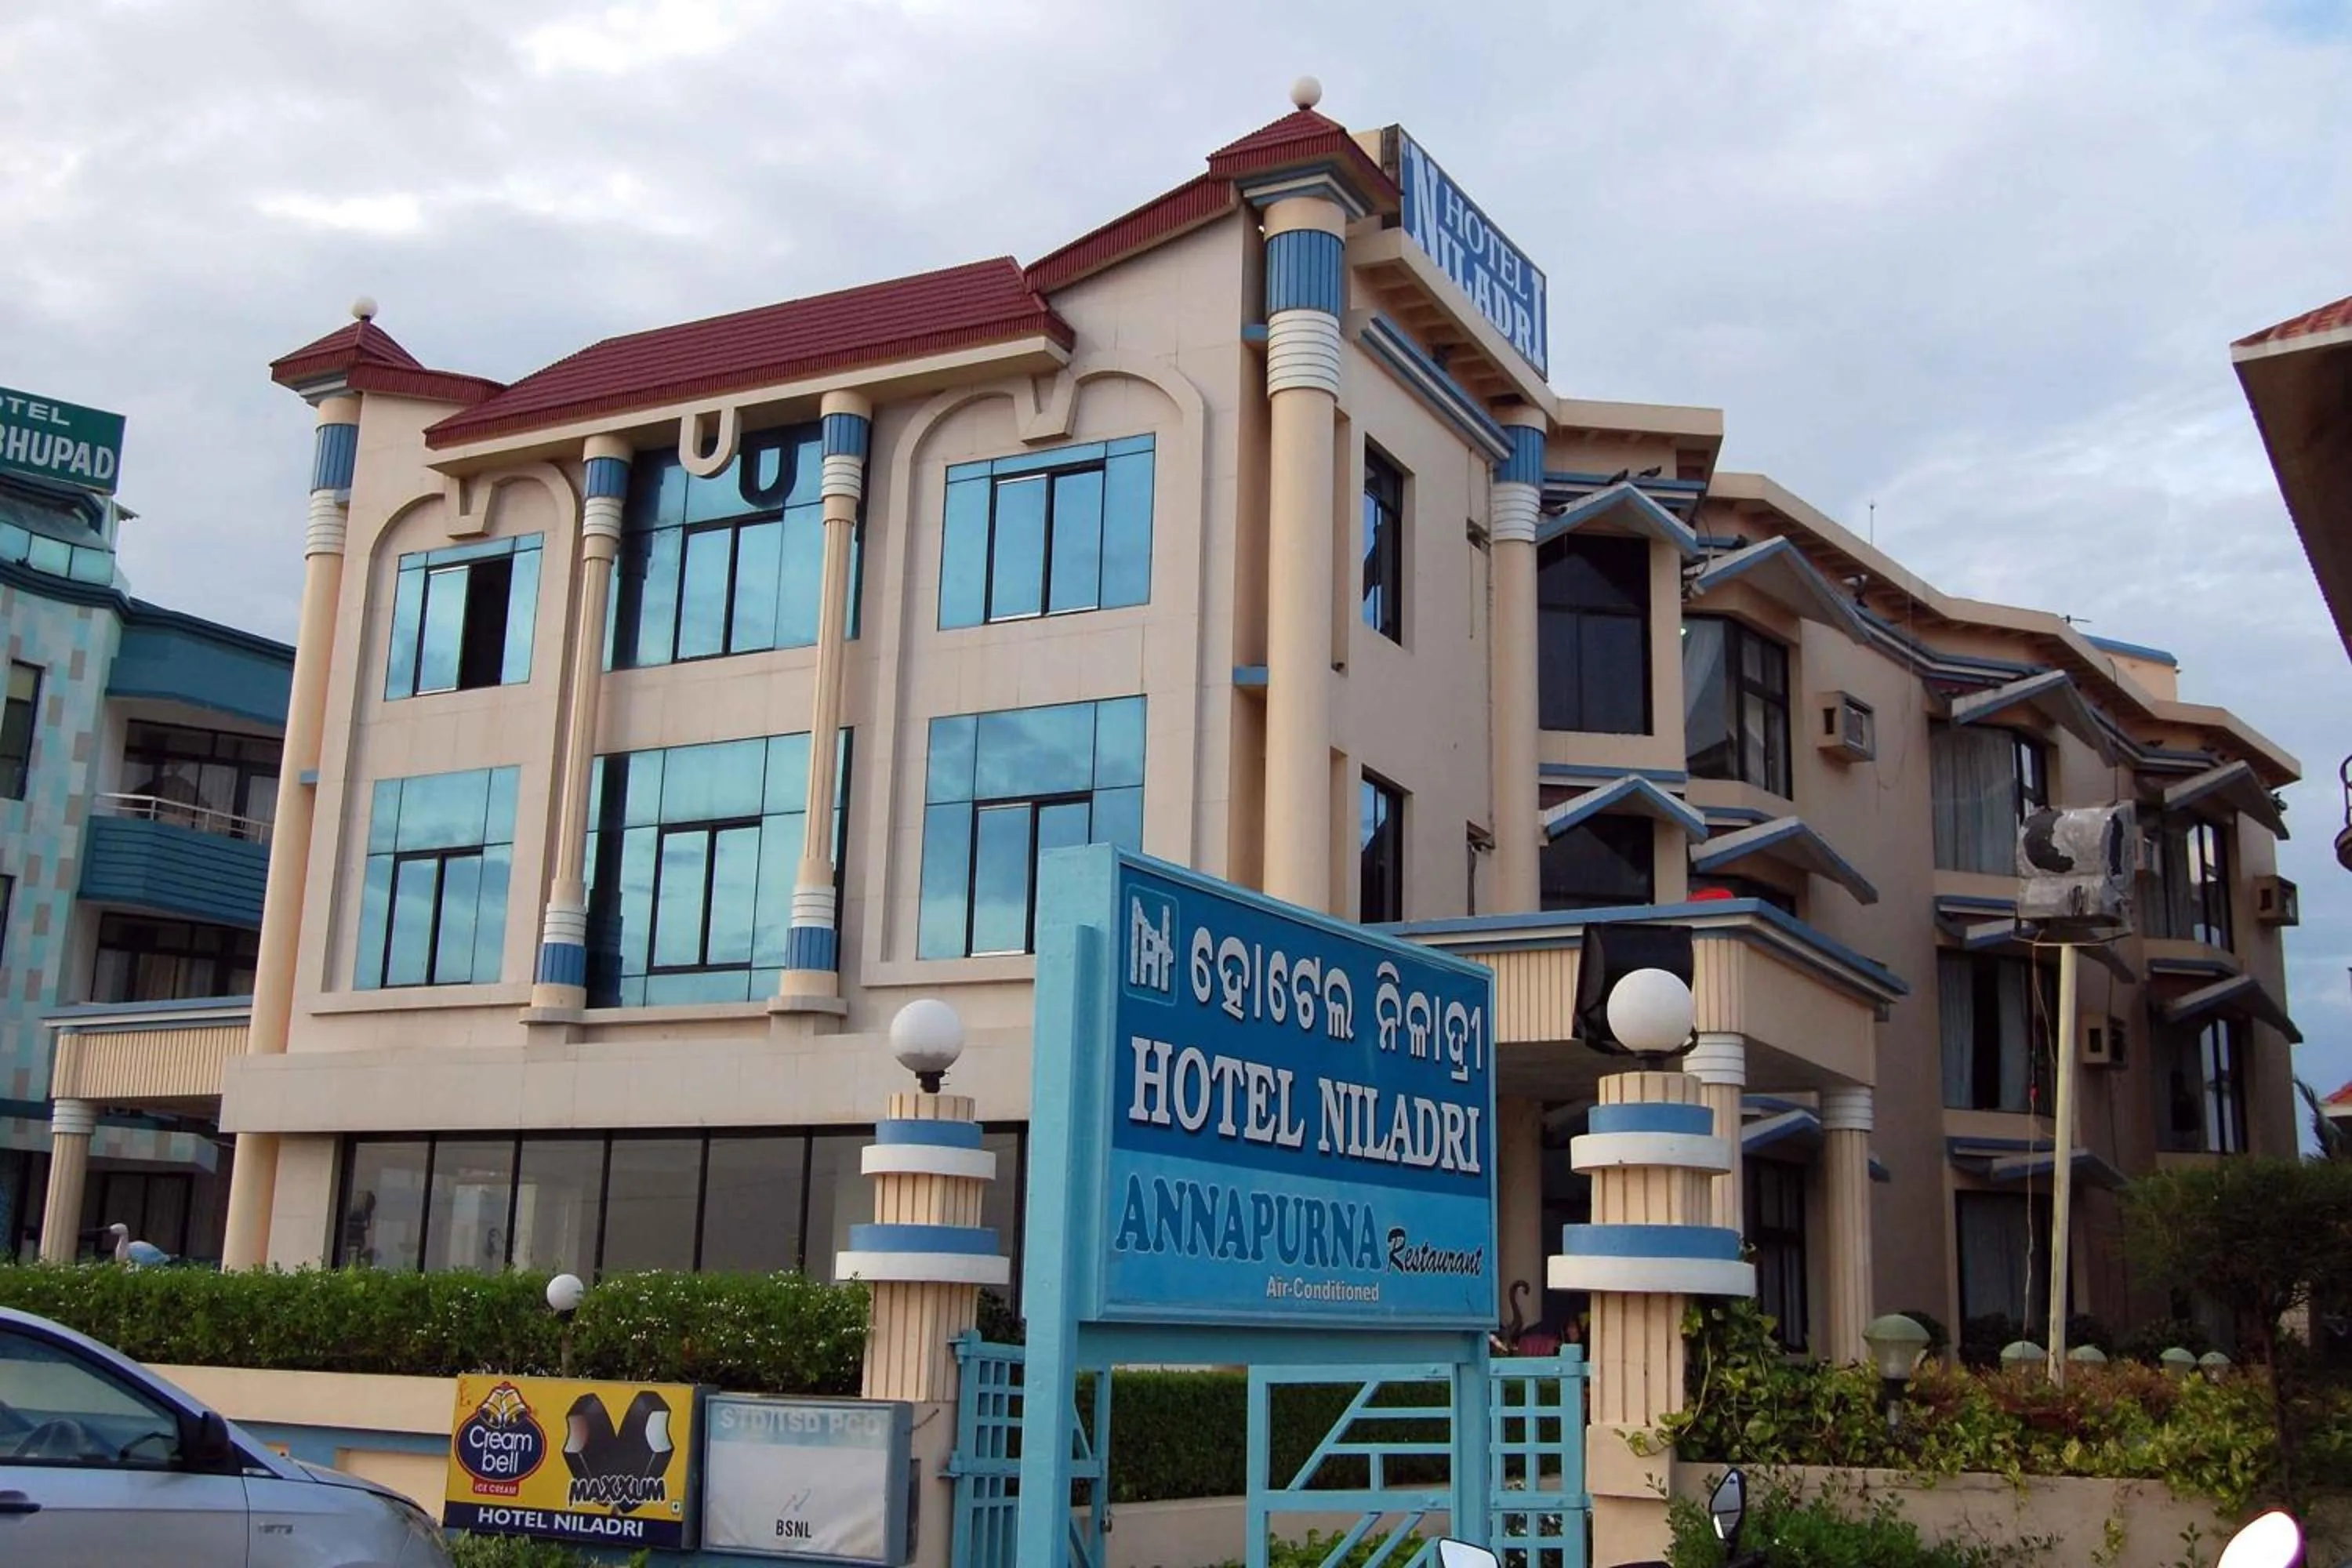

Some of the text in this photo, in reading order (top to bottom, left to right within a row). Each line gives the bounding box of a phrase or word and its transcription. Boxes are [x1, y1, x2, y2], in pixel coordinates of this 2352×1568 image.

[1401, 135, 1544, 372] NILADRI
[1444, 183, 1529, 301] HOTEL
[0, 395, 71, 426] TEL
[1190, 926, 1355, 1040] ହୋଟେଲ
[1128, 1036, 1482, 1174] HOTEL NILADRI
[1115, 1174, 1484, 1277] ANNAPURNA Restaurant
[1265, 1275, 1380, 1301] Air-Conditioned
[720, 1406, 881, 1436] STD/ISD PCO
[469, 1425, 533, 1452] Cream
[481, 1449, 519, 1474] bell
[568, 1474, 667, 1508] MAXXUM
[477, 1507, 644, 1538] HOTEL NILADRI
[775, 1519, 812, 1539] BSNL
